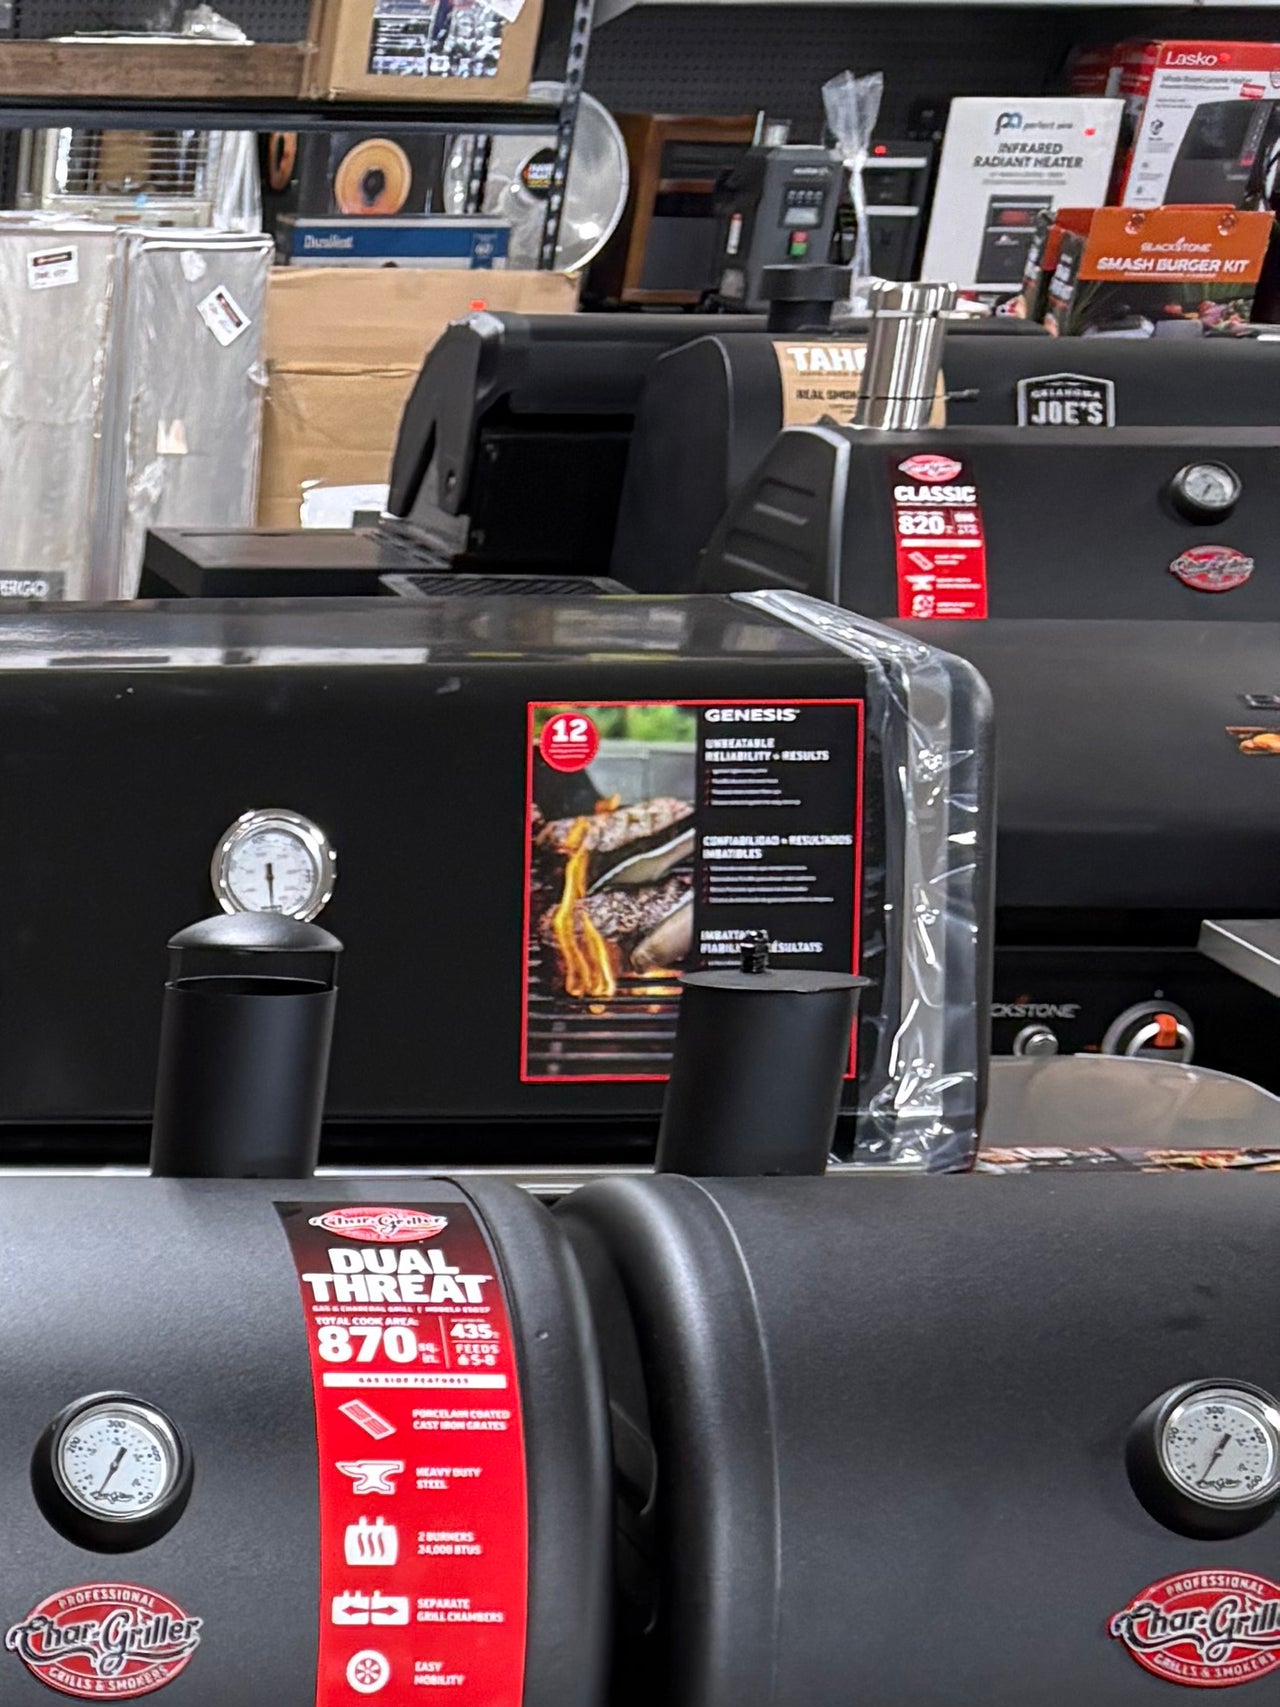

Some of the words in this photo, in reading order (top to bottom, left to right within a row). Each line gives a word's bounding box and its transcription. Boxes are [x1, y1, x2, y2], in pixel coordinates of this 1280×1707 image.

[1166, 51, 1218, 66] Lasko
[998, 143, 1063, 154] INFRARED
[973, 157, 1031, 167] RADIANT
[1033, 157, 1083, 168] HEATER
[1097, 257, 1153, 270] SMASH
[1156, 258, 1221, 272] BURGER
[1223, 260, 1249, 272] KIT
[1031, 401, 1103, 424] JOE'S
[894, 486, 976, 502] CLASSIC
[898, 516, 945, 535] 820
[704, 709, 797, 722] GENESIS
[553, 719, 587, 742] 12
[704, 738, 775, 749] UNBEATABLE
[704, 751, 770, 762] RELIABILITY
[782, 751, 829, 761] RESULTS
[788, 835, 852, 846] RESULTADOS
[991, 1004, 1081, 1018] CKSTONE
[328, 1248, 459, 1274] DUAL
[302, 1274, 493, 1303] THREAT
[316, 1317, 350, 1325] TOTAL
[352, 1317, 383, 1325] COOK
[385, 1317, 418, 1326] AREA:
[450, 1324, 491, 1339] 435
[317, 1326, 418, 1363] 870
[455, 1345, 499, 1354] FEEDS
[412, 1409, 468, 1418] PORCELAIN
[470, 1410, 510, 1419] COATED
[1205, 1406, 1225, 1415] 300
[107, 1420, 126, 1428] 300
[413, 1421, 439, 1430] CAST
[440, 1421, 465, 1430] IRON
[467, 1422, 507, 1430] GRATES
[416, 1468, 451, 1477] HEAVY
[452, 1468, 481, 1477] DUTY
[416, 1480, 447, 1489] STEEL
[418, 1532, 425, 1541] 2
[427, 1532, 474, 1541] BURNERS
[454, 1546, 481, 1555] BTUS
[1166, 1575, 1265, 1596] PROFESSIONAL
[58, 1588, 155, 1609] PROFESSIONAL
[417, 1599, 470, 1609] SEPARATE
[417, 1612, 446, 1622] GRILL
[447, 1613, 504, 1622] CHAMBERS
[1111, 1596, 1280, 1664] Char-Grill
[5, 1608, 203, 1676] Char-Griller
[415, 1662, 442, 1672] EASY
[1153, 1653, 1198, 1677] GRILLS
[1215, 1652, 1276, 1678] SMOKERS
[48, 1666, 91, 1691] GRILLS
[108, 1665, 169, 1691] SMOKERS
[414, 1675, 464, 1685] MOBILITY
